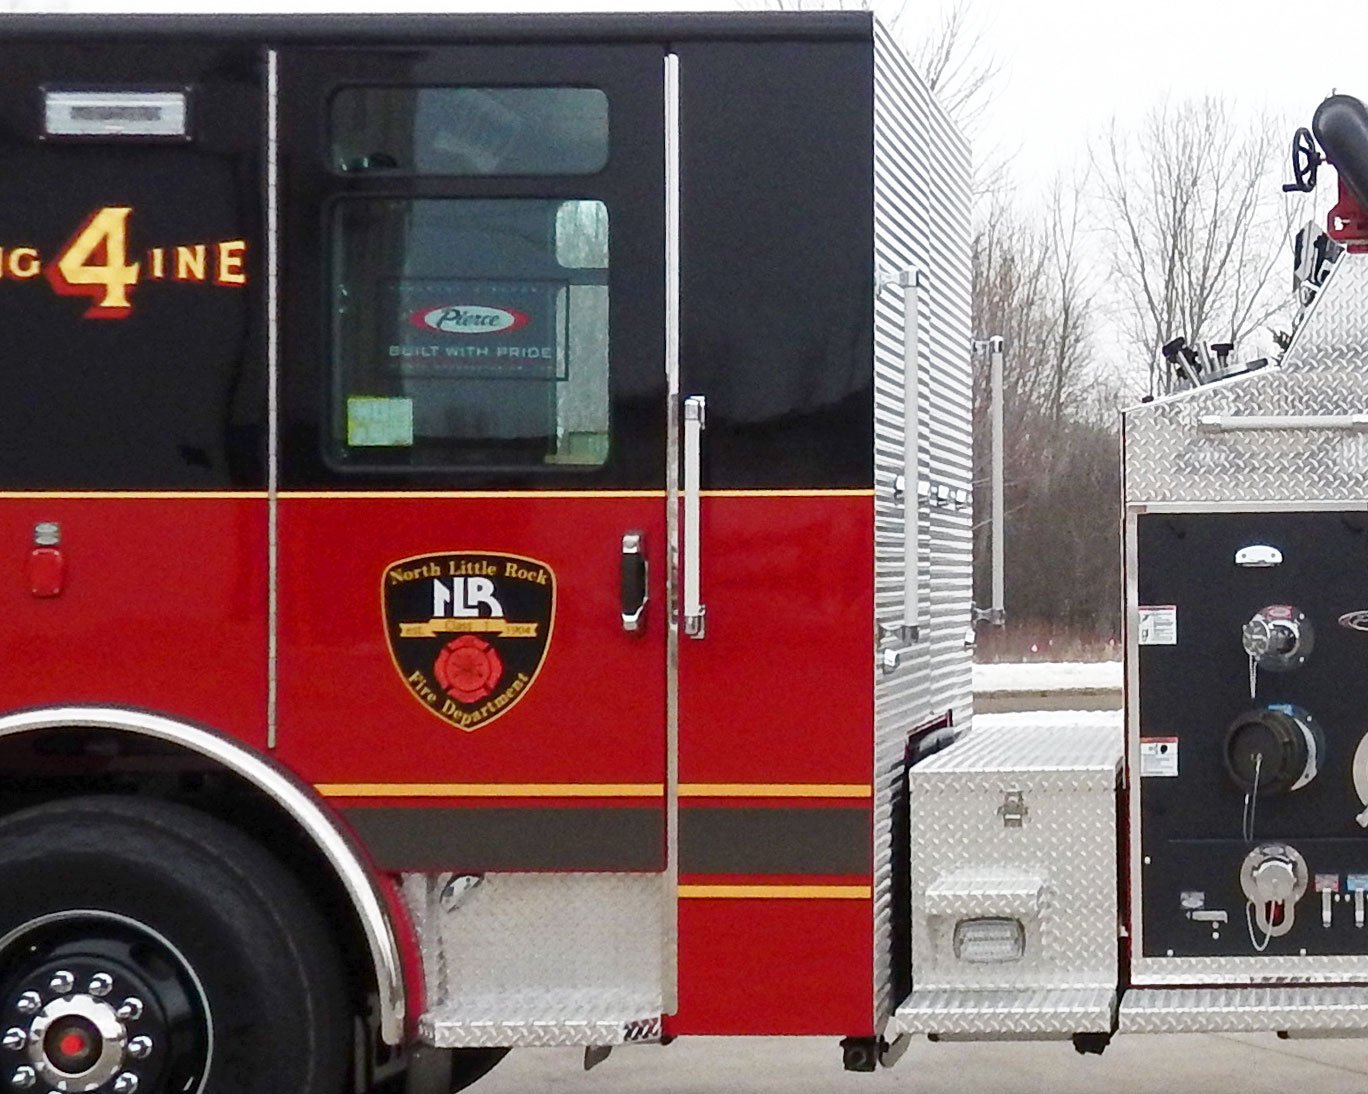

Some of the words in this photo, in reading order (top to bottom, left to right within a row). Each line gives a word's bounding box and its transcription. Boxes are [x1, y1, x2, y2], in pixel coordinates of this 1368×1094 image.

[436, 308, 499, 329] Pierce
[388, 345, 439, 357] BUILT
[445, 346, 489, 357] WITH
[497, 346, 552, 359] PRIDE
[390, 562, 441, 585] North
[450, 560, 497, 576] Little
[505, 562, 549, 585] Rock
[408, 670, 437, 702] Fire
[441, 672, 529, 726] Department
